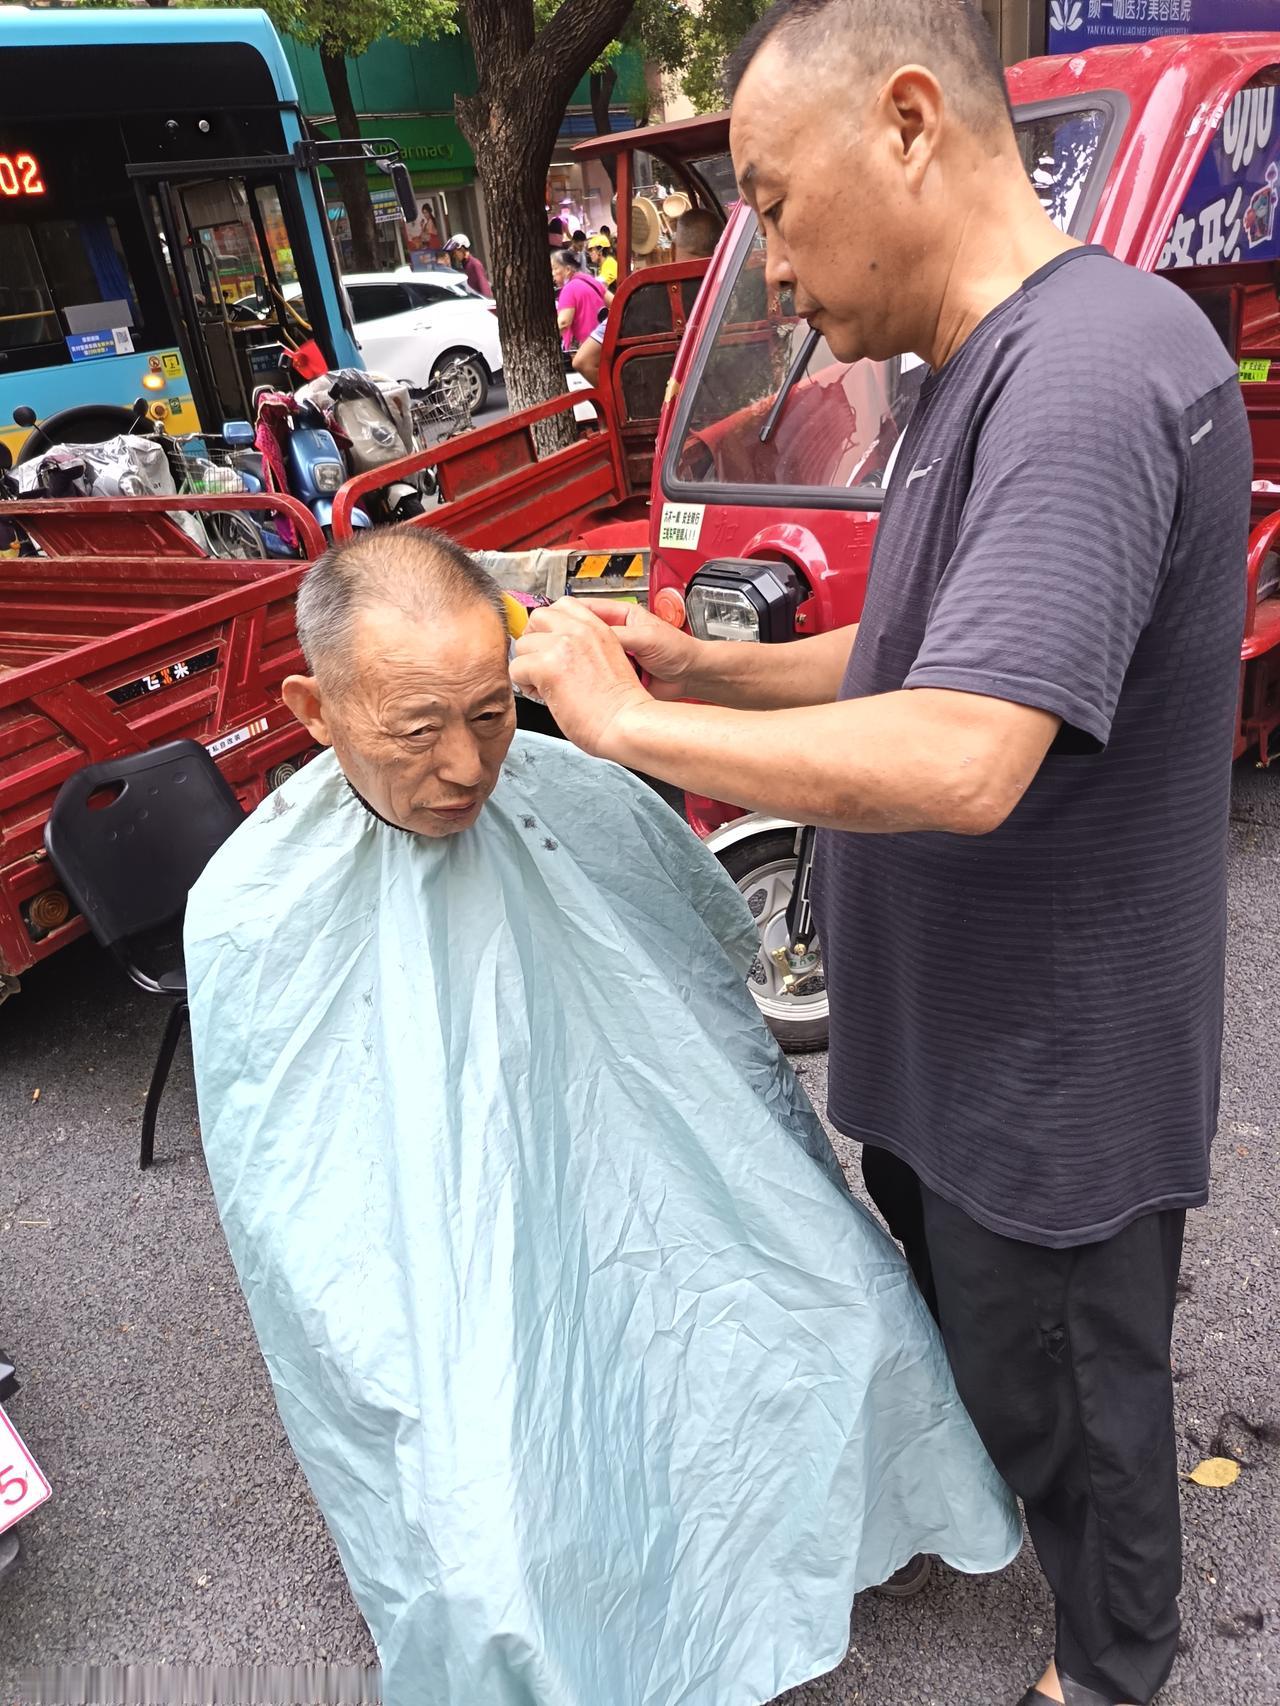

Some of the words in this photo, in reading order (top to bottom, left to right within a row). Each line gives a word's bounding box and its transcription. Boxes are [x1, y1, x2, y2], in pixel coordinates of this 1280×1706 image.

[1087, 25, 1099, 35] YAN
[1107, 26, 1115, 35] KA
[0, 155, 44, 195] 02
[0, 1464, 28, 1505] 5
